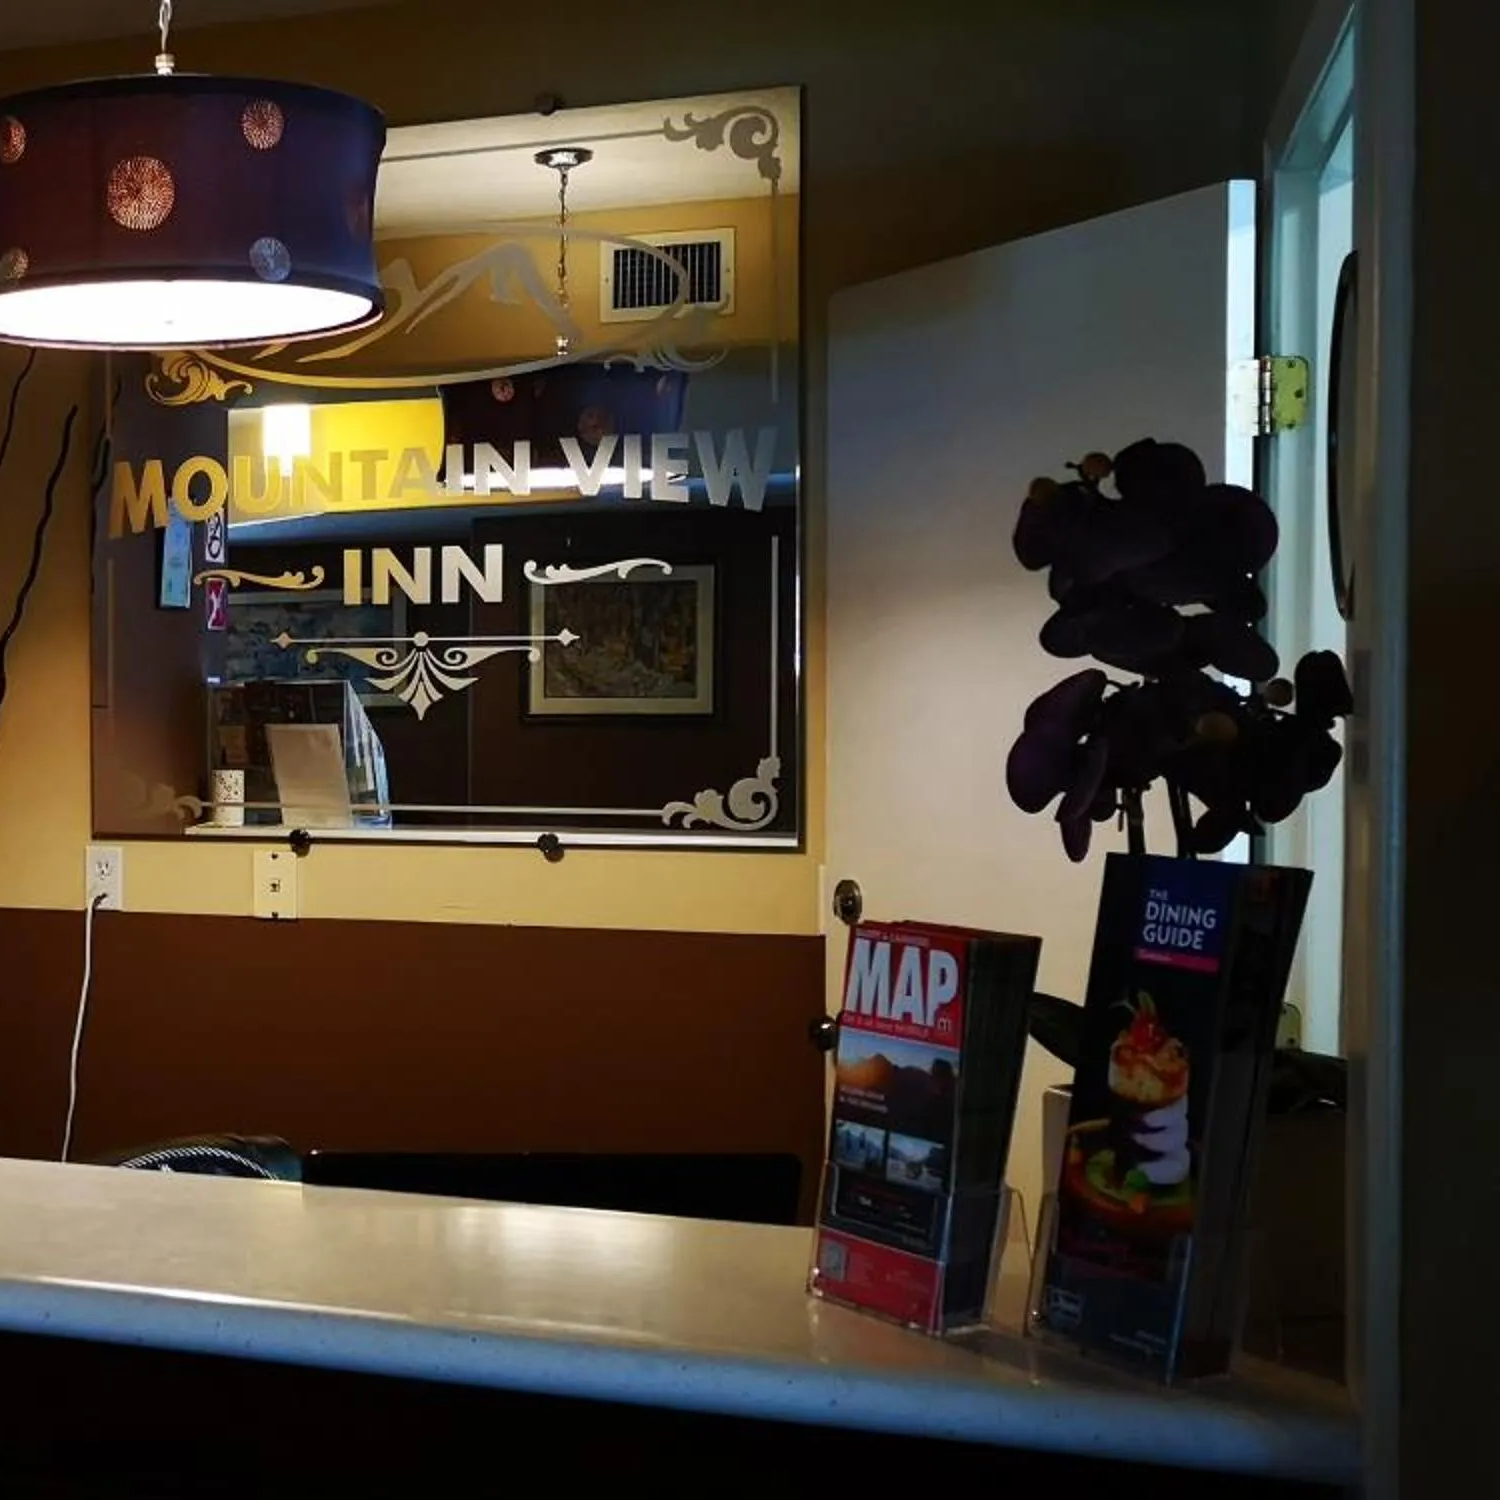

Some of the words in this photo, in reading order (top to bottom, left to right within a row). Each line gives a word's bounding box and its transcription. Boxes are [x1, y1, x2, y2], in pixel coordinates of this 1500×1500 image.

[109, 438, 531, 540] MOUNTAIN
[560, 426, 778, 512] VIEW
[343, 544, 504, 605] INN
[1145, 900, 1218, 930] DINING
[1148, 888, 1169, 901] THE
[1142, 923, 1206, 950] GUIDE
[845, 937, 959, 1028] MAP
